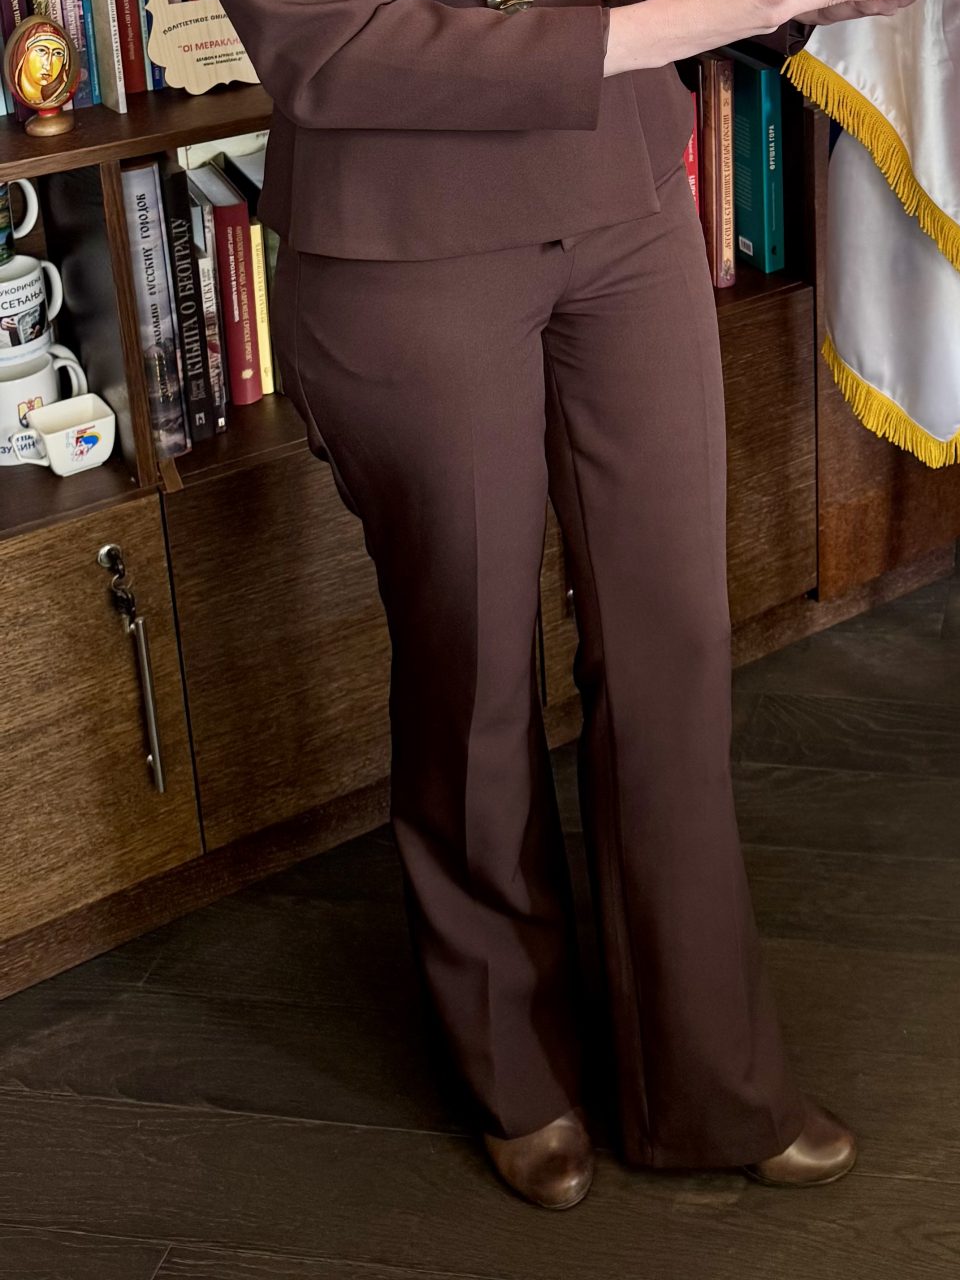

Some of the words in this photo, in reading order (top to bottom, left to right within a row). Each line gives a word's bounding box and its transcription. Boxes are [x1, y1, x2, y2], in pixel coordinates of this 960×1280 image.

[195, 37, 240, 51] ΜΕΡΑΚΛΗ
[171, 217, 195, 297] БЕОГРАДУ
[180, 301, 197, 314] О
[182, 317, 203, 377] КЊИГА
